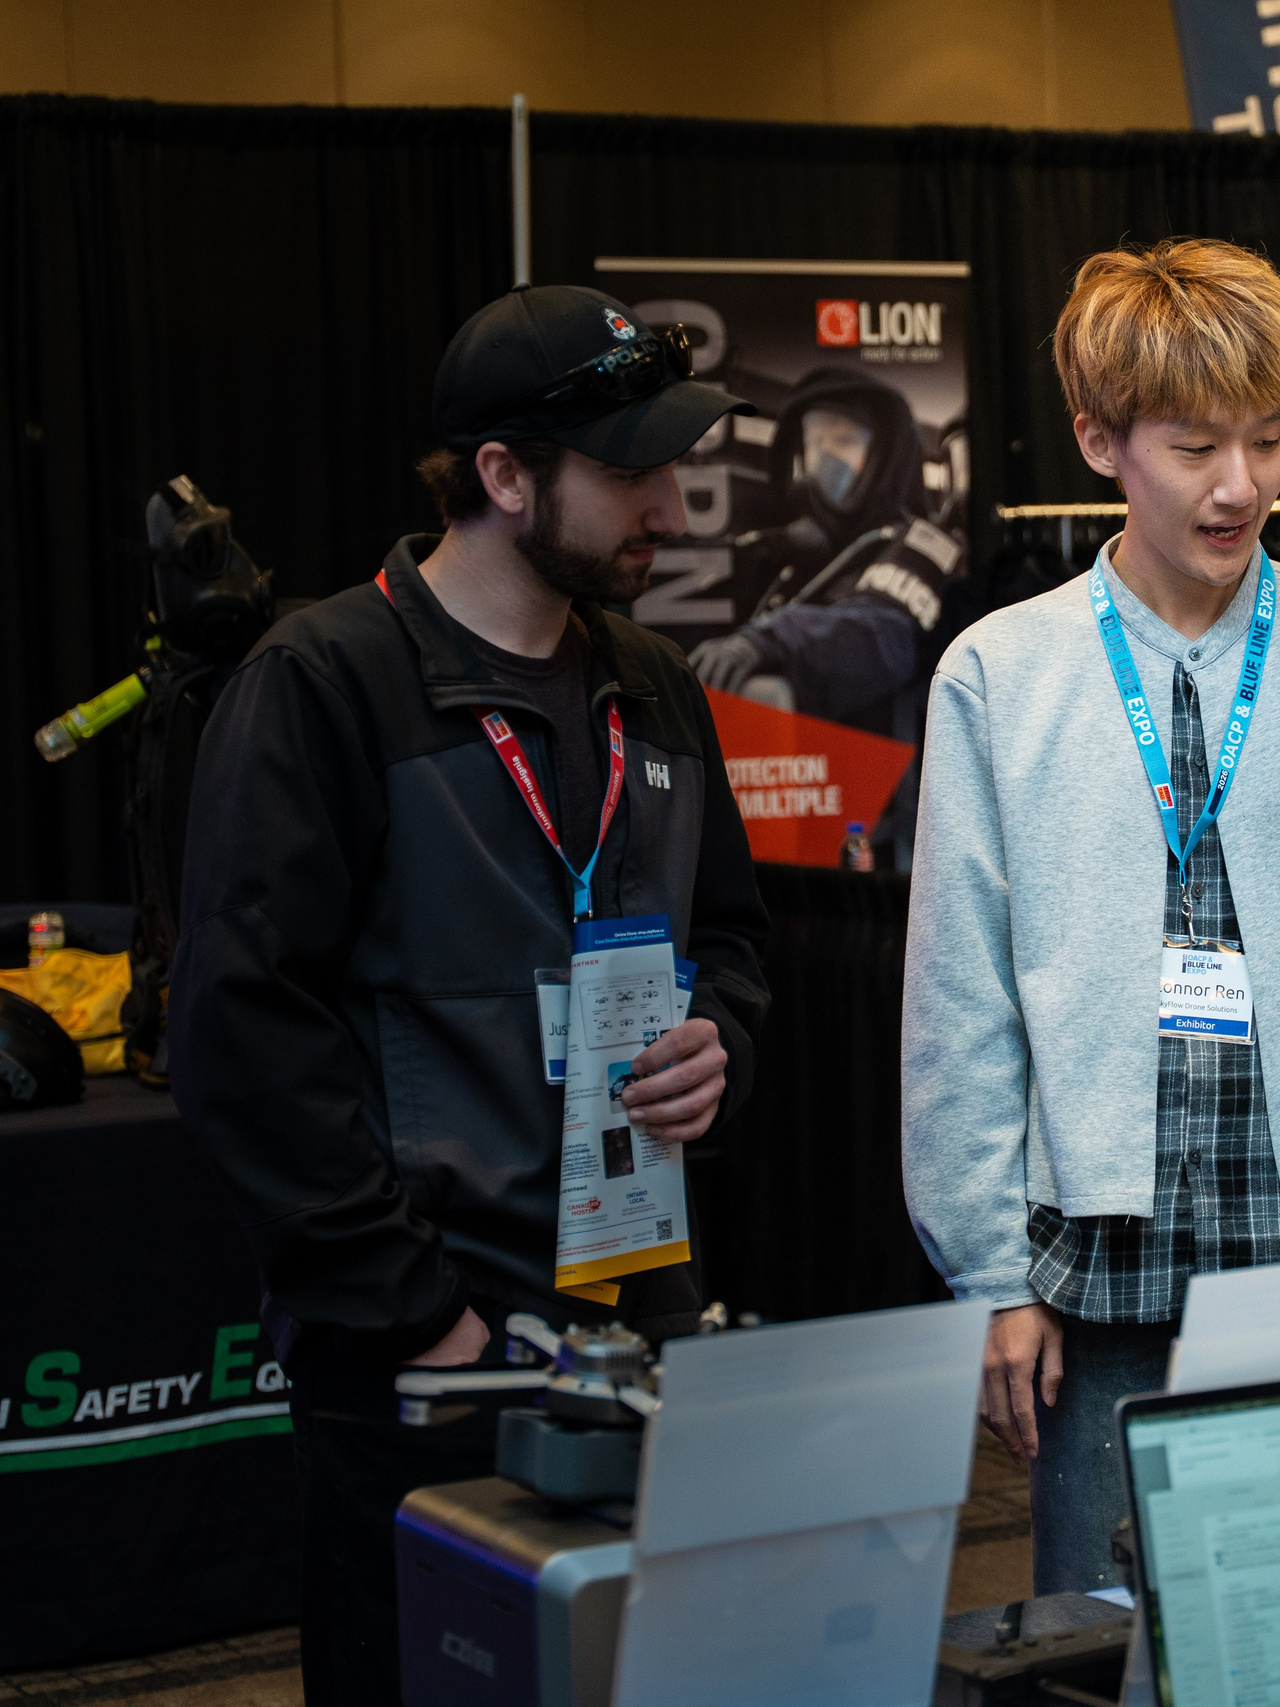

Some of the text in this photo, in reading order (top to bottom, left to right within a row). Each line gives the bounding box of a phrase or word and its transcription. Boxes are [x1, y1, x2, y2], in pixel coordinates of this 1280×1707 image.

[859, 301, 942, 347] LION
[1100, 613, 1121, 654] BLUE
[1114, 656, 1140, 697] LINE
[1127, 696, 1156, 746] EXPO
[1220, 578, 1276, 770] OACP & BLUE LINE EXPO
[644, 760, 671, 790] HH
[1216, 769, 1230, 791] 2026
[511, 755, 552, 831] Uniform Insignia
[737, 784, 842, 820] MULTIPLE
[1187, 954, 1207, 962] OACP
[1187, 960, 1223, 970] BLUE LINE
[1160, 983, 1245, 1000] onnor Ren
[1185, 1003, 1206, 1011] Drone
[1206, 1004, 1238, 1014] Solutions
[1176, 1019, 1216, 1031] Exhibitor
[625, 1190, 648, 1199] ONTARIO
[629, 1197, 645, 1205] LOCAL
[567, 1202, 599, 1211] CANADIAN
[20, 1350, 203, 1428] SAFETY
[209, 1322, 292, 1400] EQ
